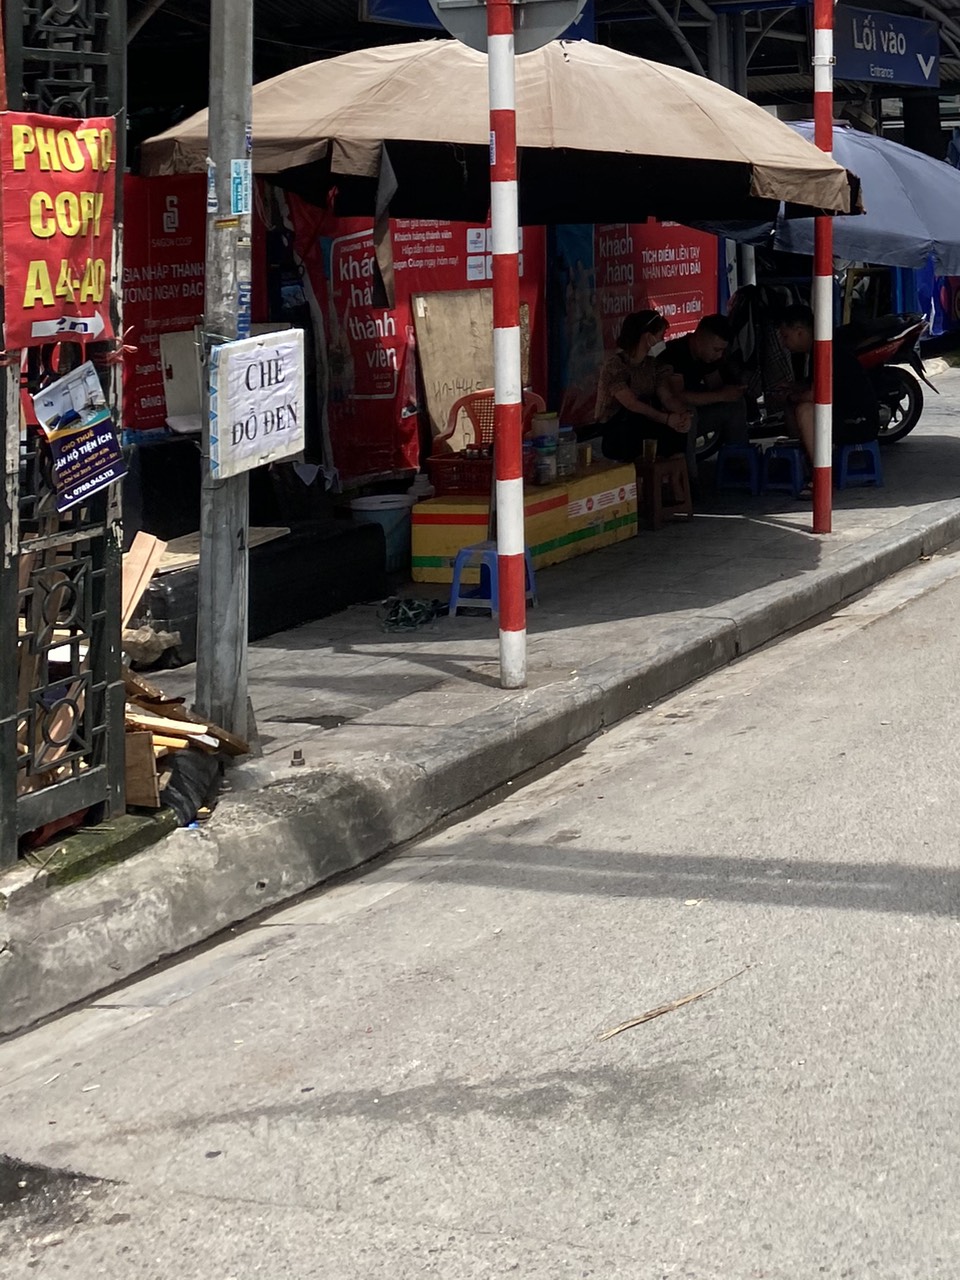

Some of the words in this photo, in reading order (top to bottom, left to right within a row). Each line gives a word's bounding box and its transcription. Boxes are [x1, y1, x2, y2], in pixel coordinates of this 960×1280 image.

[852, 14, 877, 51] Lối
[880, 24, 906, 55] vào
[869, 63, 894, 78] Entrance
[12, 124, 113, 173] PHOTO
[599, 233, 633, 258] khách
[642, 247, 657, 263] TÍCH
[658, 244, 675, 262] ĐIỂM
[690, 244, 701, 259] TAY
[123, 268, 141, 283] GIA
[170, 260, 205, 279] THÀNH
[338, 251, 375, 282] khác
[606, 259, 634, 287] hàng
[661, 263, 679, 279] NGAY
[154, 283, 181, 301] NGAY
[349, 311, 396, 341] thành
[245, 349, 286, 392] CHÈ
[262, 401, 299, 436] ĐEN
[61, 440, 76, 453] CHO
[76, 429, 95, 444] THUÊ
[66, 448, 79, 462] HỘ
[78, 439, 98, 455] TIỆN
[96, 431, 113, 446] ÍCH
